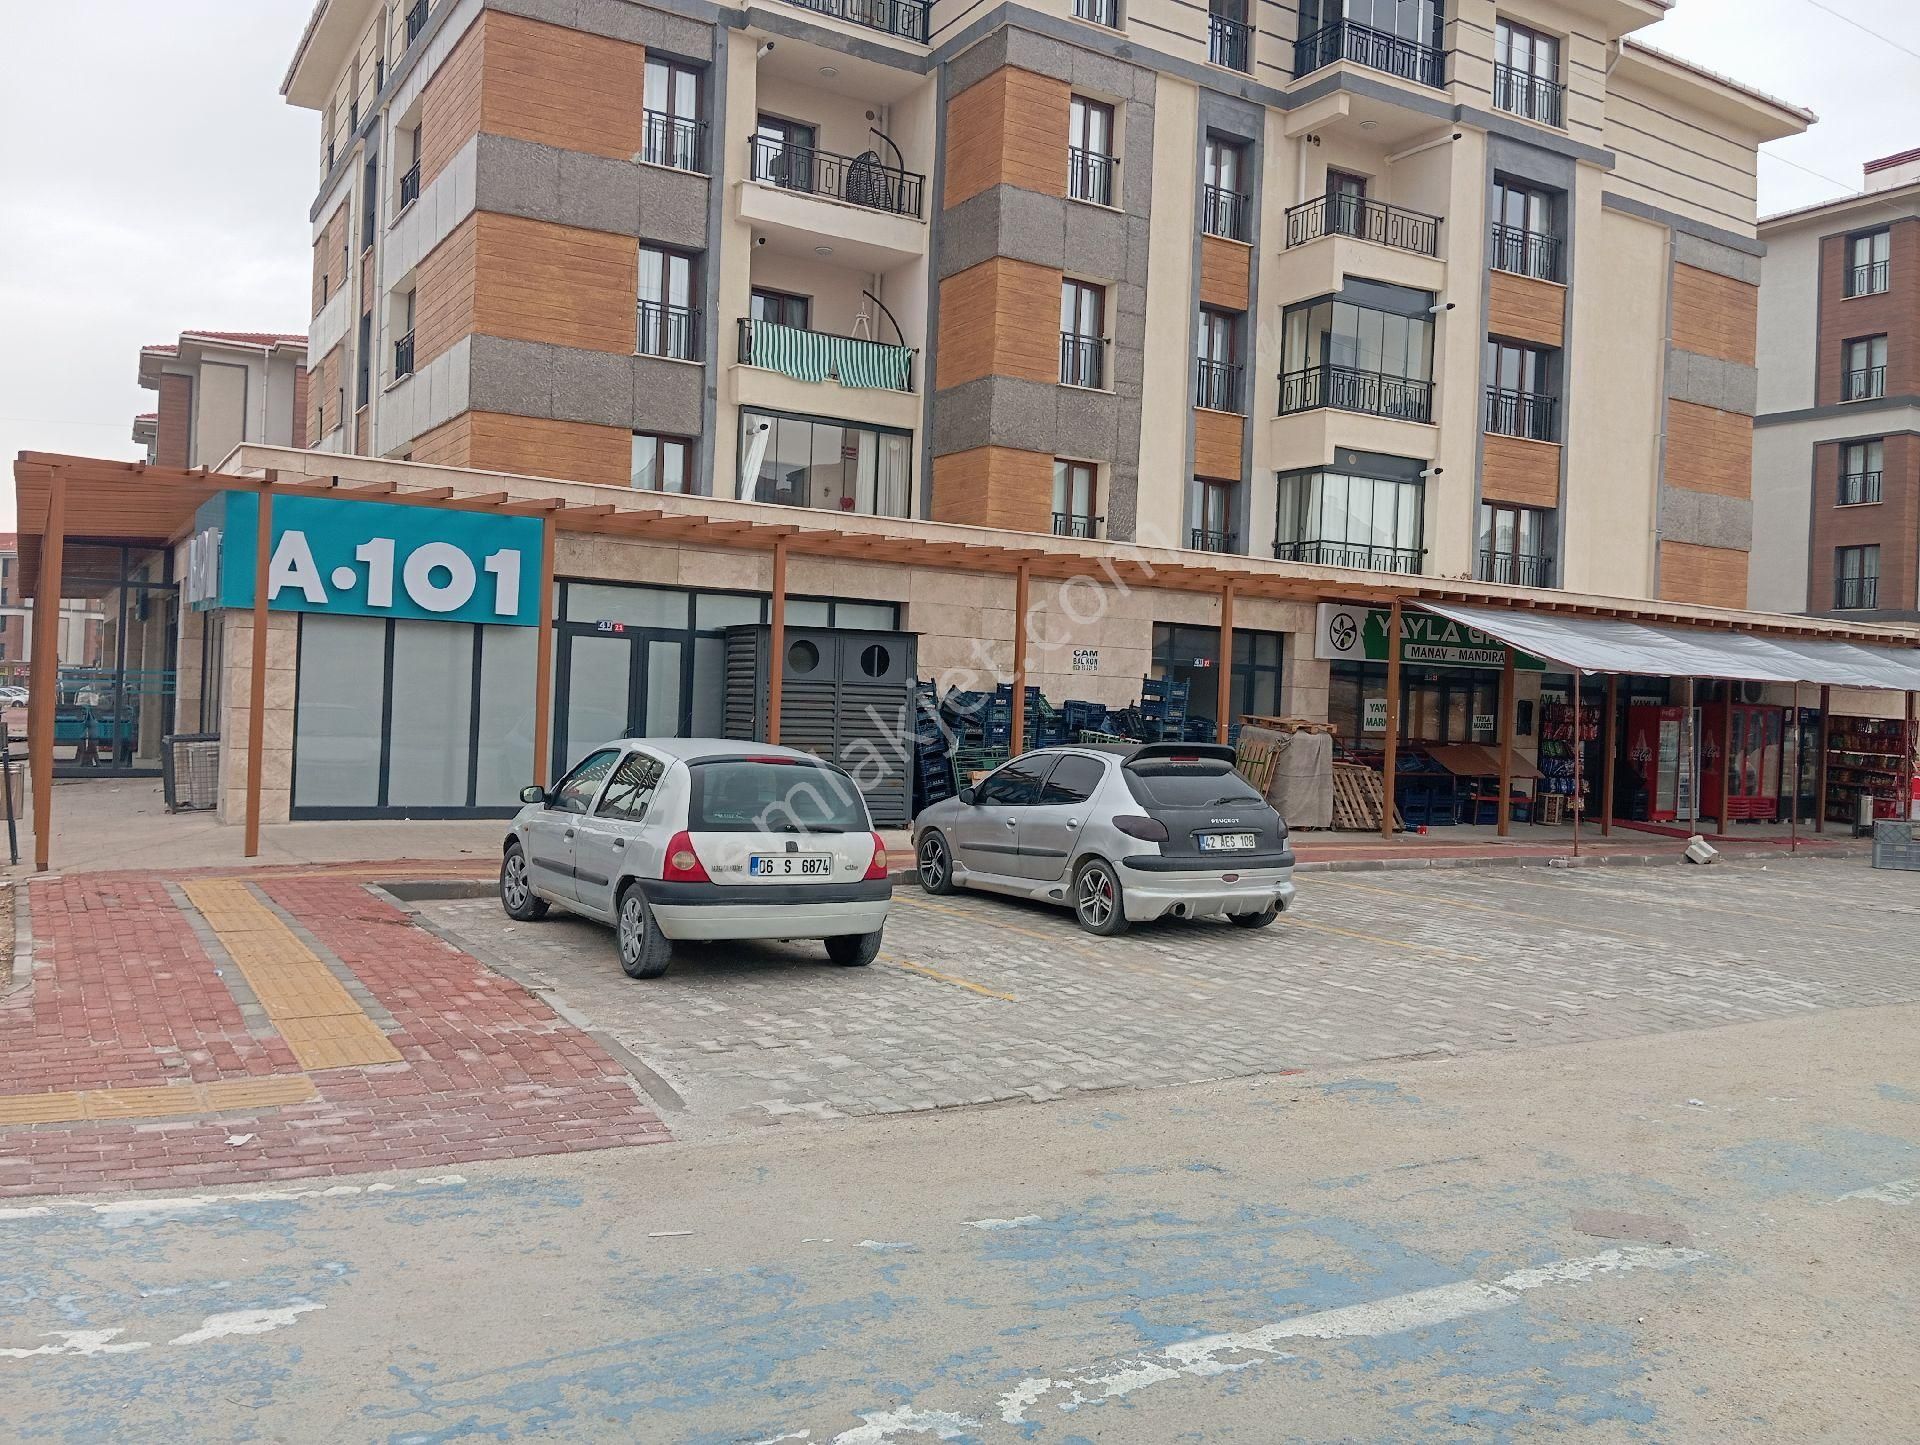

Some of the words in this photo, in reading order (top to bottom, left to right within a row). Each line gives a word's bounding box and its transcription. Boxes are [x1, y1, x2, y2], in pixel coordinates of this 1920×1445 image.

[1073, 649, 1098, 657] CAM
[1411, 646, 1448, 660] MANAV
[1458, 650, 1505, 663] MANDIRA
[1205, 836, 1216, 848] 42
[1220, 835, 1236, 848] AES
[1240, 835, 1254, 847] 108
[759, 859, 774, 874] 06
[784, 859, 792, 873] S
[802, 858, 829, 874] 6874
